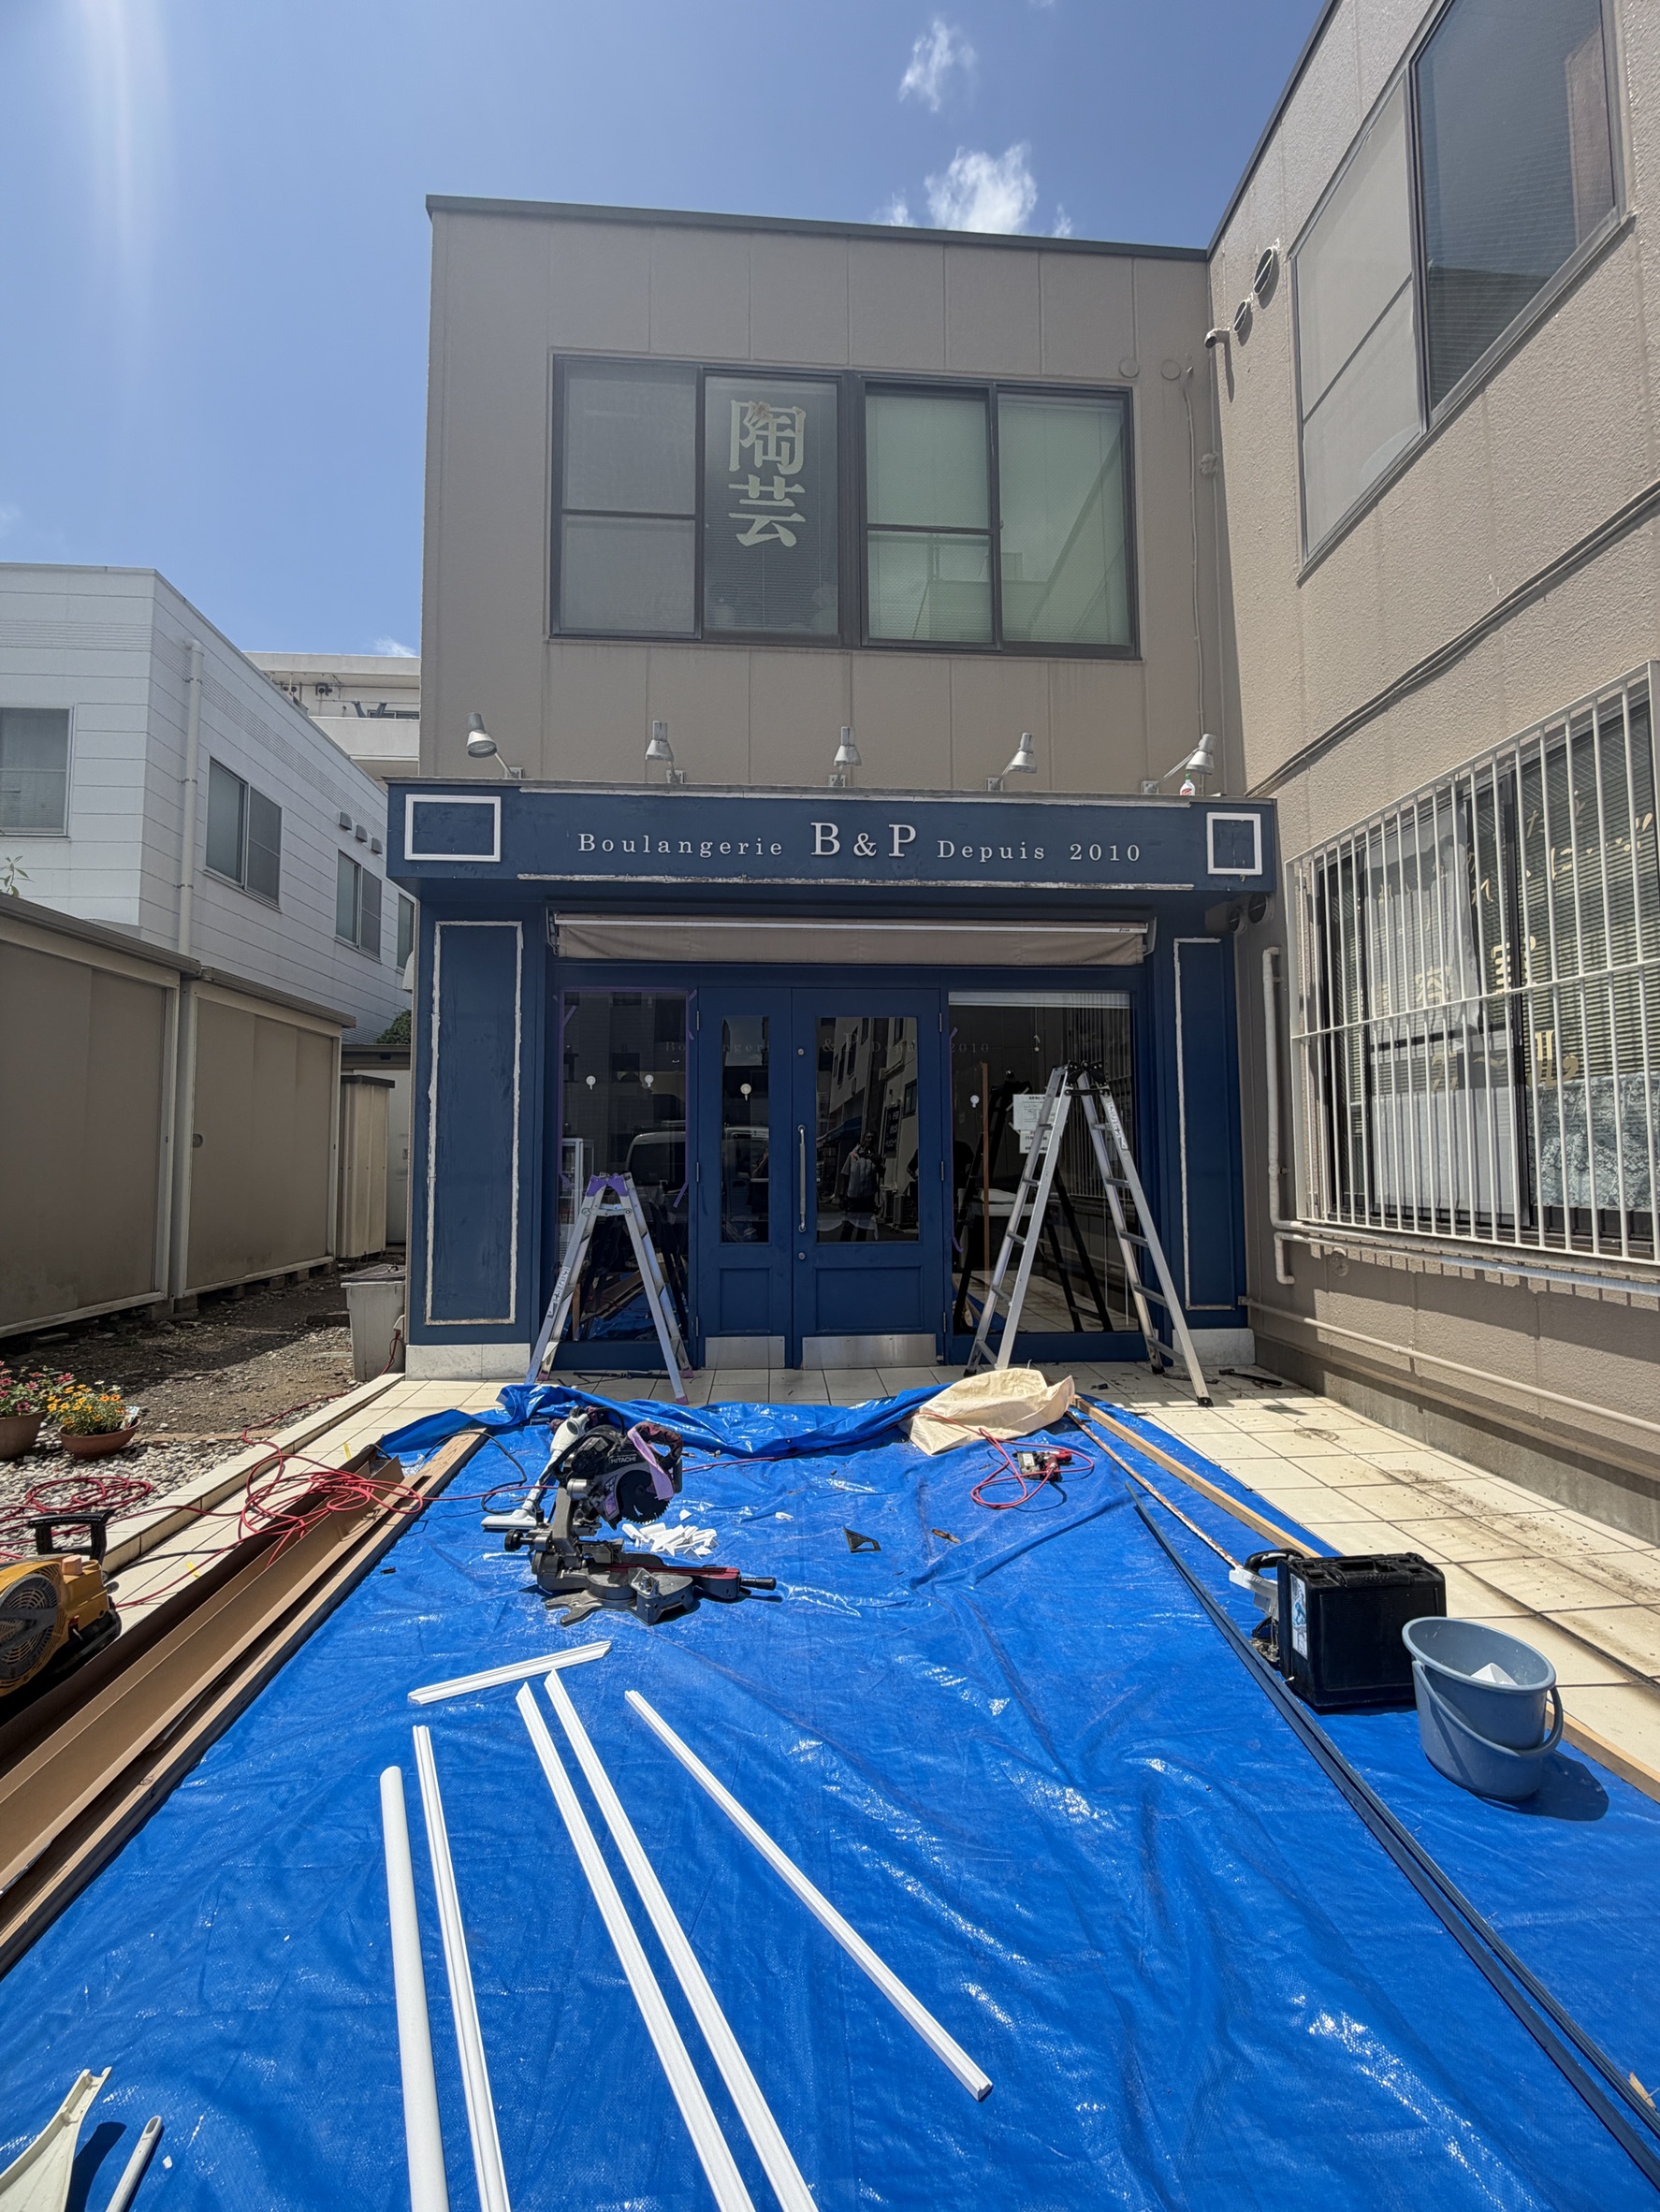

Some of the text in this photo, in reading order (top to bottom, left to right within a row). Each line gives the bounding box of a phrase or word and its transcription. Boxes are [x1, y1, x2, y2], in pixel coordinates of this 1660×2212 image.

[728, 400, 807, 547] 陶芸
[577, 833, 783, 859] Boulangerie
[937, 839, 1045, 863] Depuis
[1070, 843, 1141, 862] 2010
[610, 1456, 636, 1464] HITACHI
